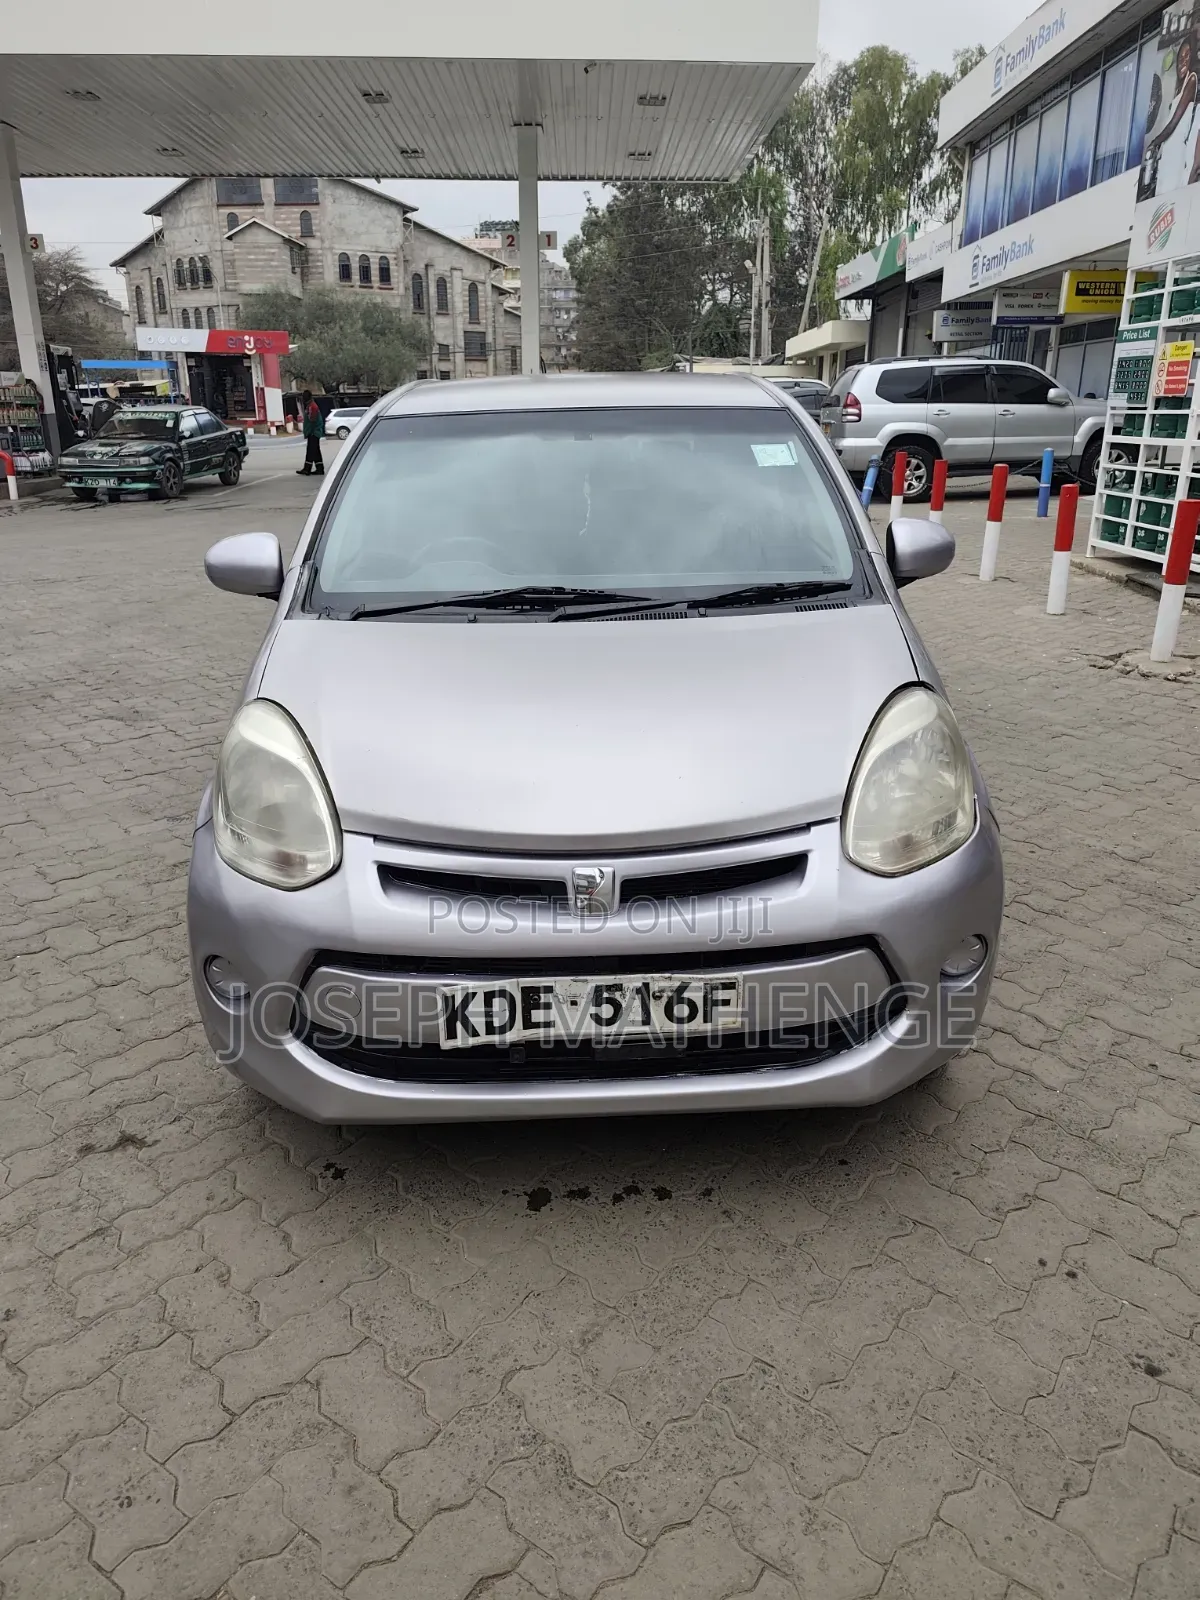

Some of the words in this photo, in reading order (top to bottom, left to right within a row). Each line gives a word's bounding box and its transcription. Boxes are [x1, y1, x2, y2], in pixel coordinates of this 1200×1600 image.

[29, 236, 39, 249] 3
[506, 234, 515, 247] 2
[545, 234, 551, 247] 1
[1122, 331, 1138, 340] Price
[1139, 329, 1151, 338] List
[444, 982, 556, 1040] KDE
[589, 981, 737, 1027] 516F
